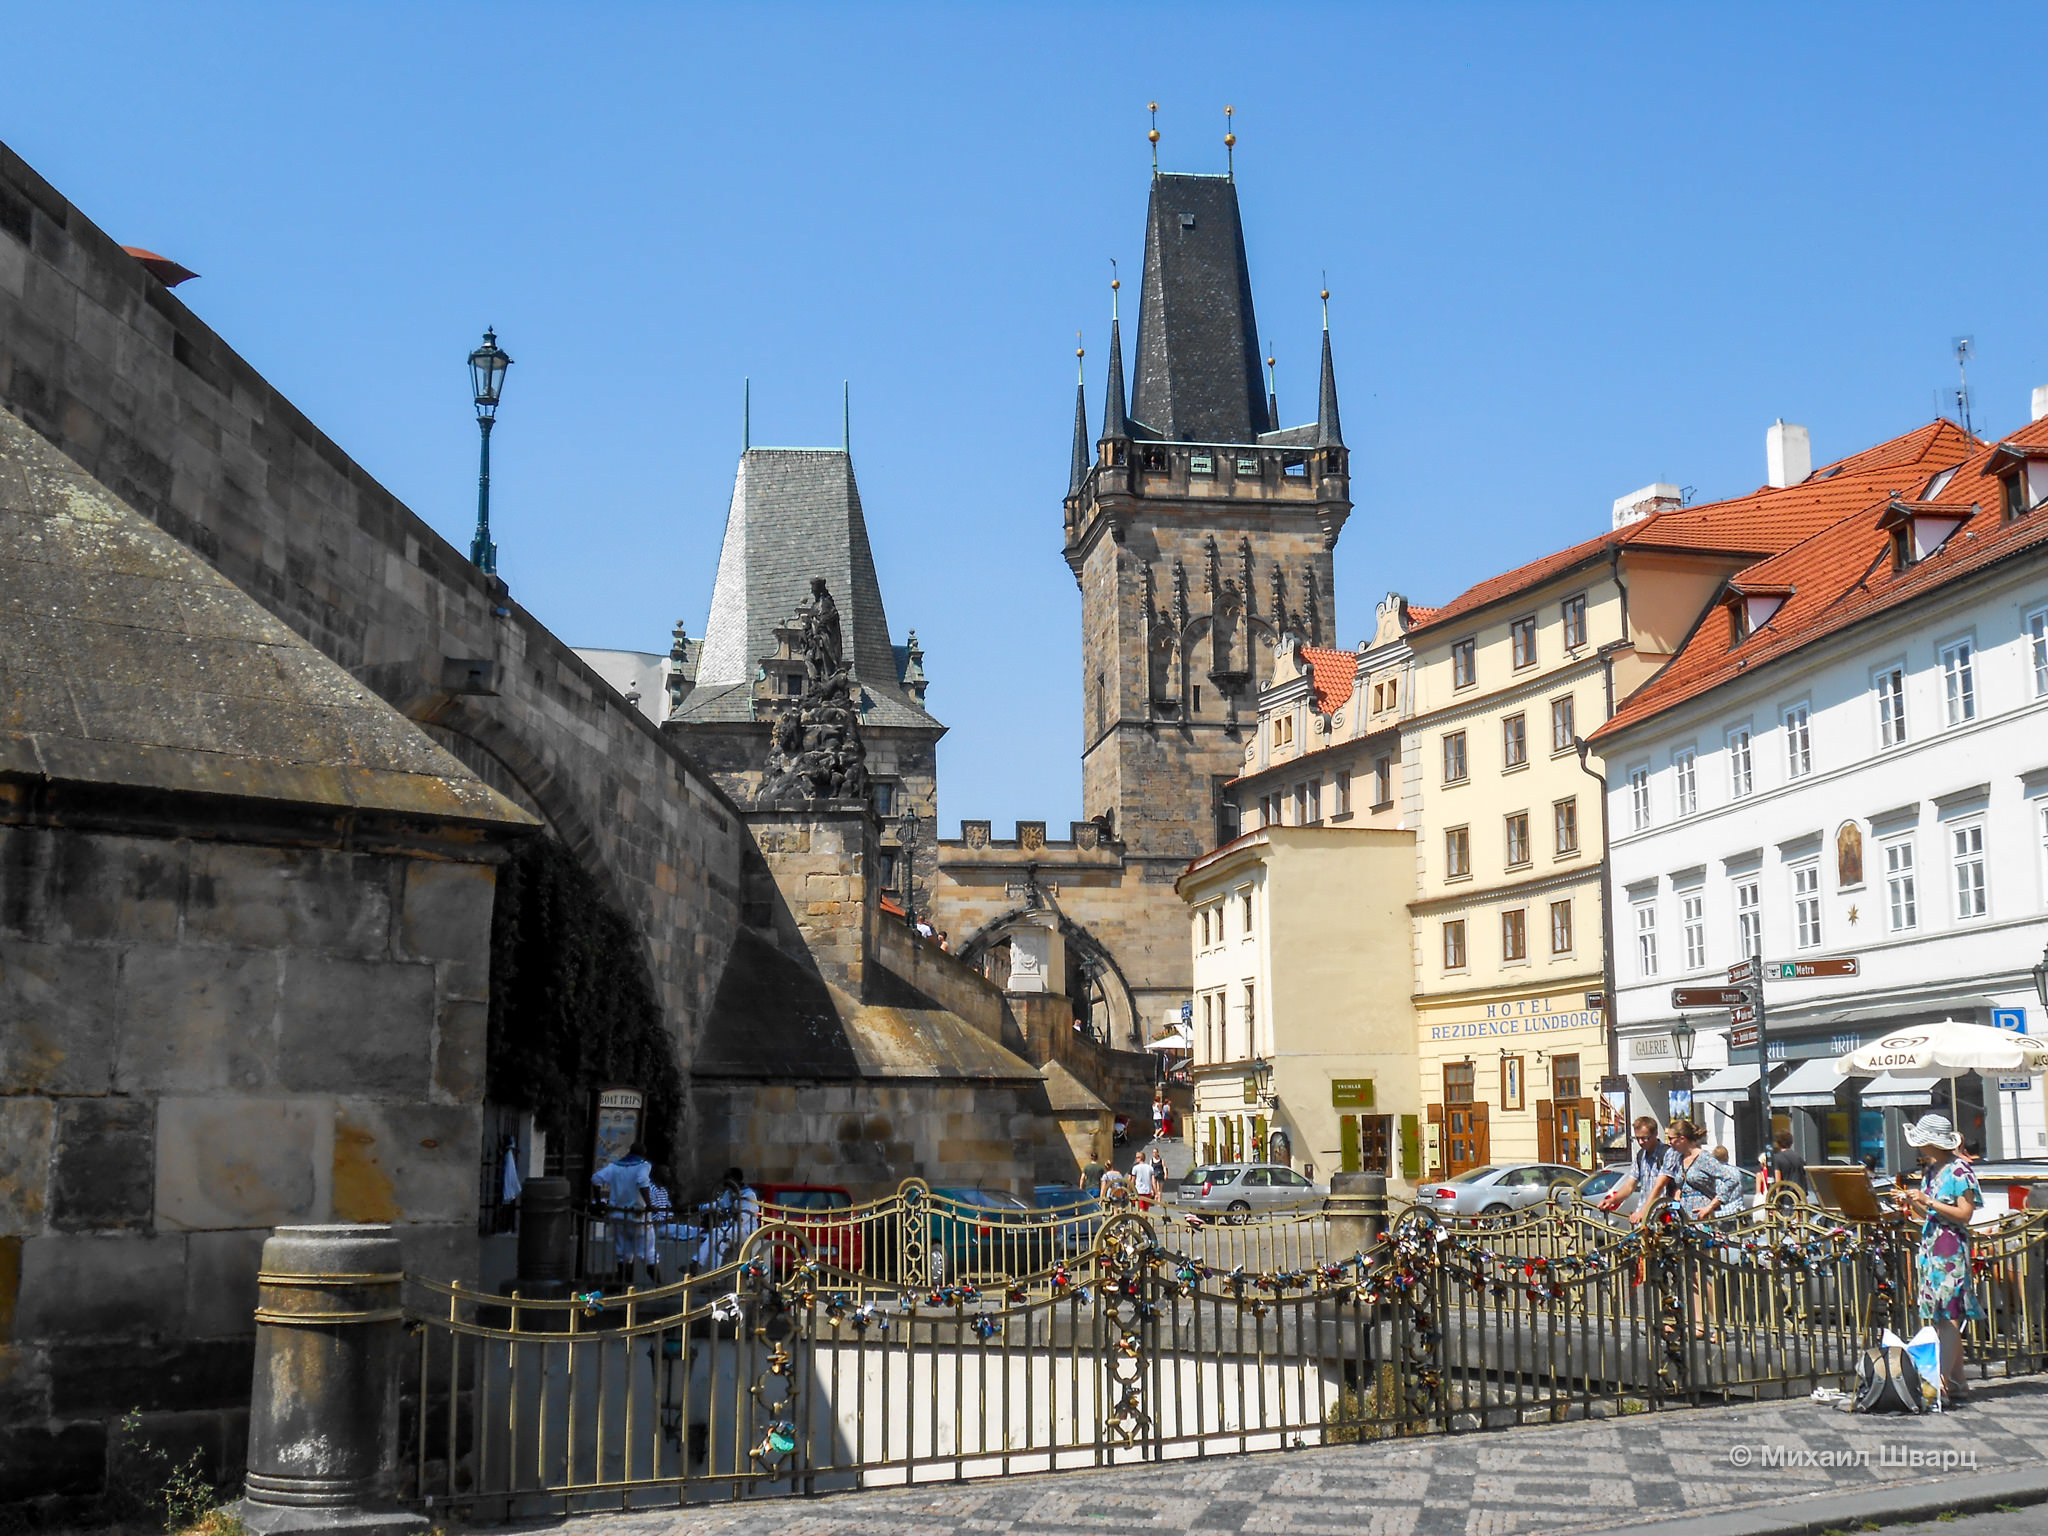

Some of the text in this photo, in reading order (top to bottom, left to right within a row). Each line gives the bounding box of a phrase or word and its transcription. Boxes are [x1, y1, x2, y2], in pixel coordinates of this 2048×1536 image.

[1784, 965, 1815, 976] A Metro
[1721, 992, 1740, 1004] Kampa
[1487, 998, 1552, 1018] HOTEL
[1432, 1011, 1600, 1039] REZIDENCE LUNDBORG
[1635, 1039, 1668, 1056] GALERIE
[1868, 1054, 1916, 1067] ALGIDA
[600, 1094, 641, 1105] BOAT TRIPS
